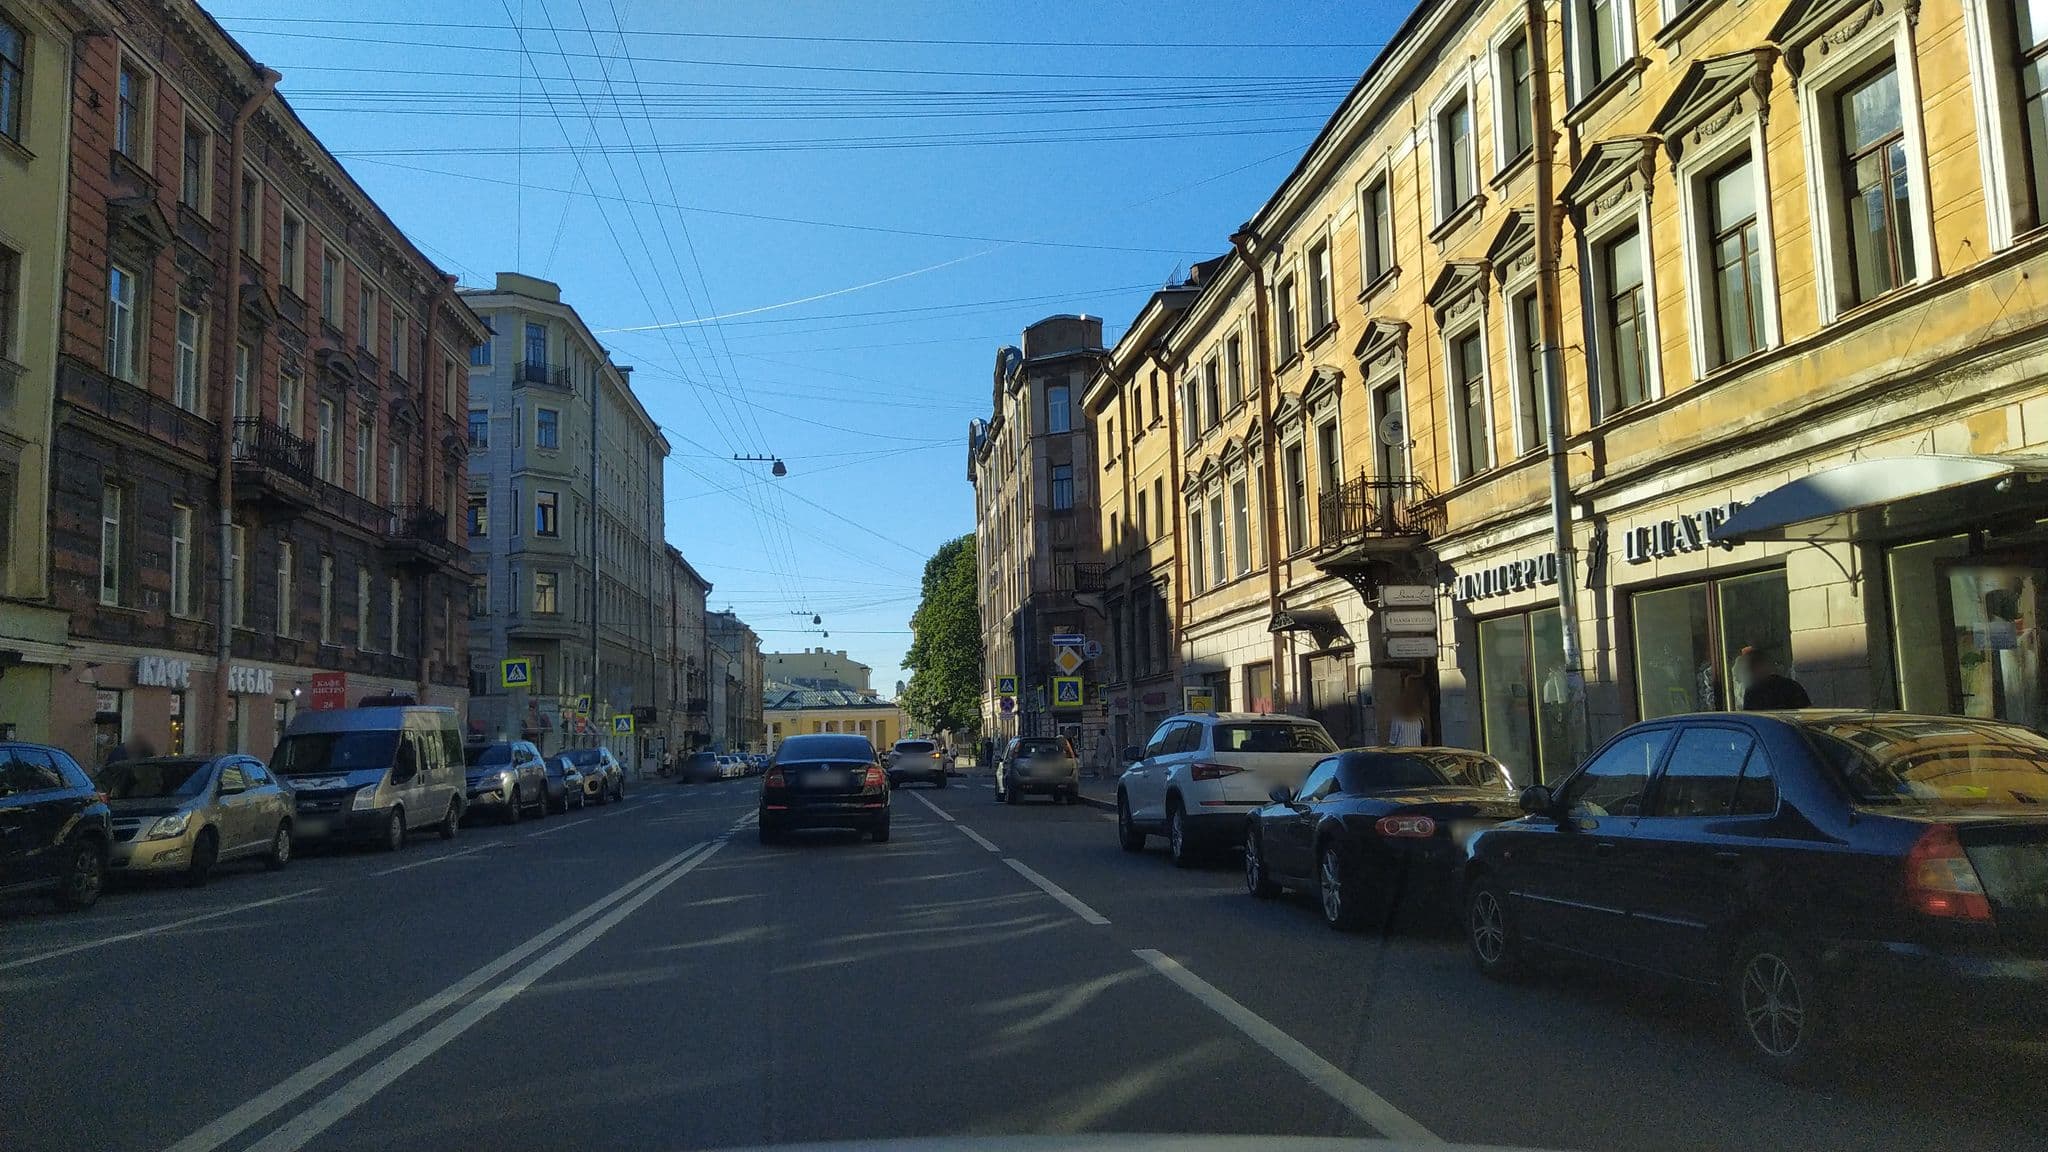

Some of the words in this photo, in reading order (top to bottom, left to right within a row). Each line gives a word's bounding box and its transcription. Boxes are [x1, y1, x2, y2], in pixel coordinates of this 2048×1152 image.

[1455, 552, 1559, 601] ИМПЕРИ
[138, 655, 190, 688] КАФЕ
[228, 665, 273, 695] КЕБАБ
